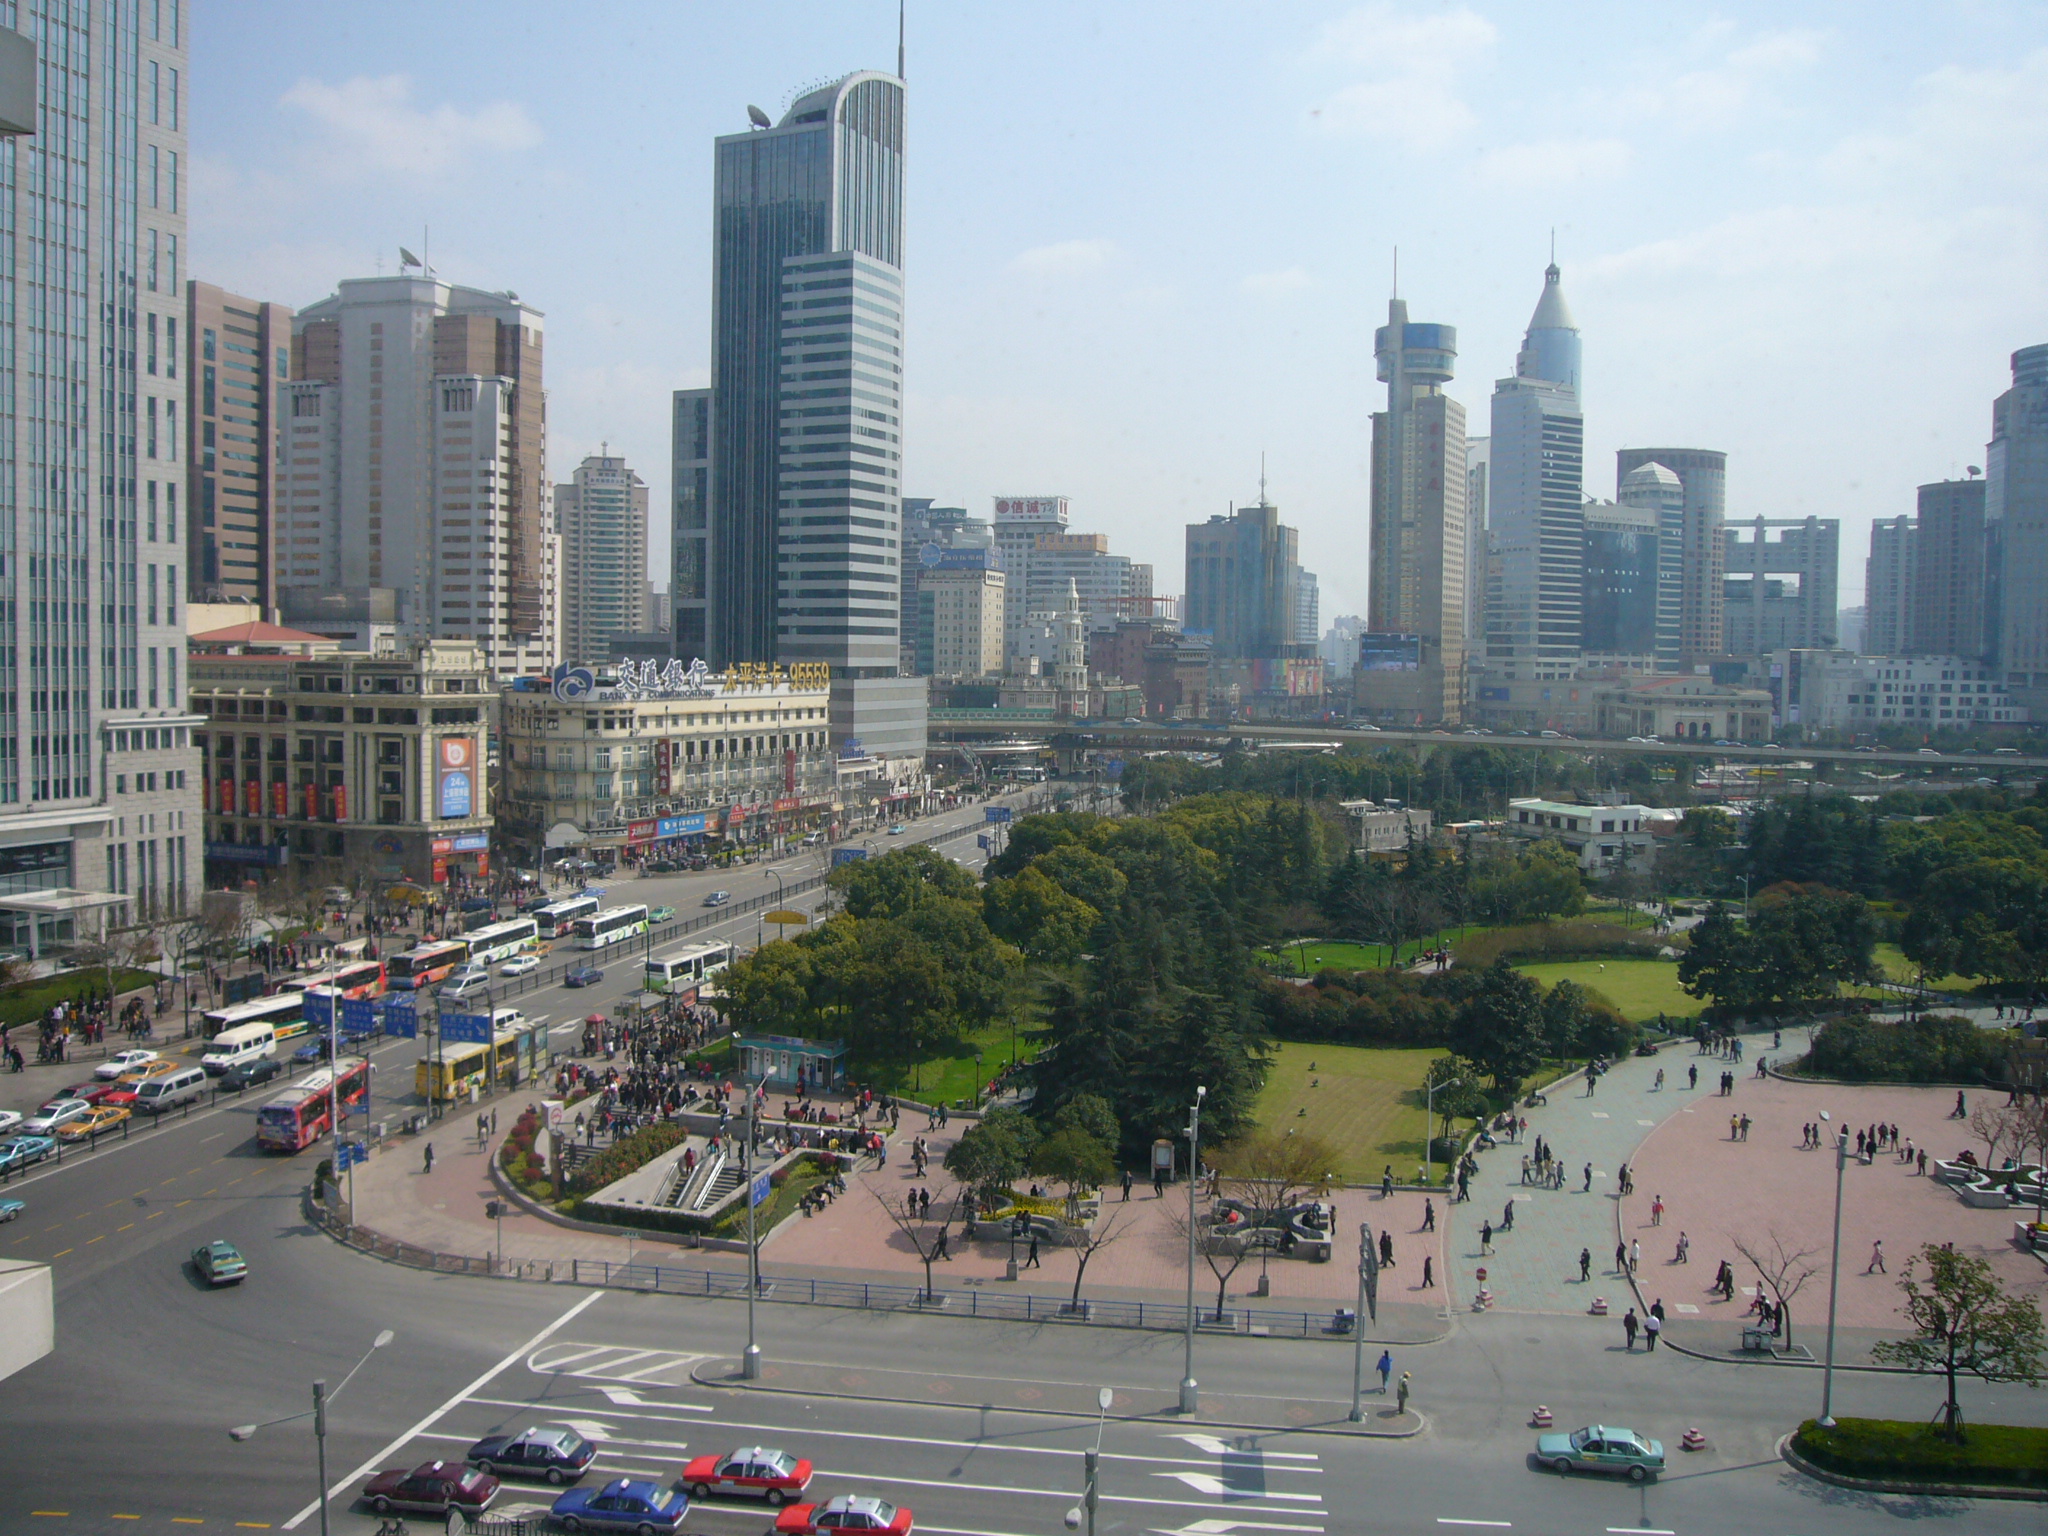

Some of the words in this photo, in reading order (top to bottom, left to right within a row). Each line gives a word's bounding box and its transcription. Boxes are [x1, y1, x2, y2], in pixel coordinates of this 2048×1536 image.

[1011, 500, 1039, 514] 信诚
[723, 661, 783, 691] 太平洋卡
[789, 661, 830, 690] 95559
[599, 691, 628, 700] BANK
[632, 691, 644, 700] OF
[648, 689, 716, 699] COMMUNICATIONS
